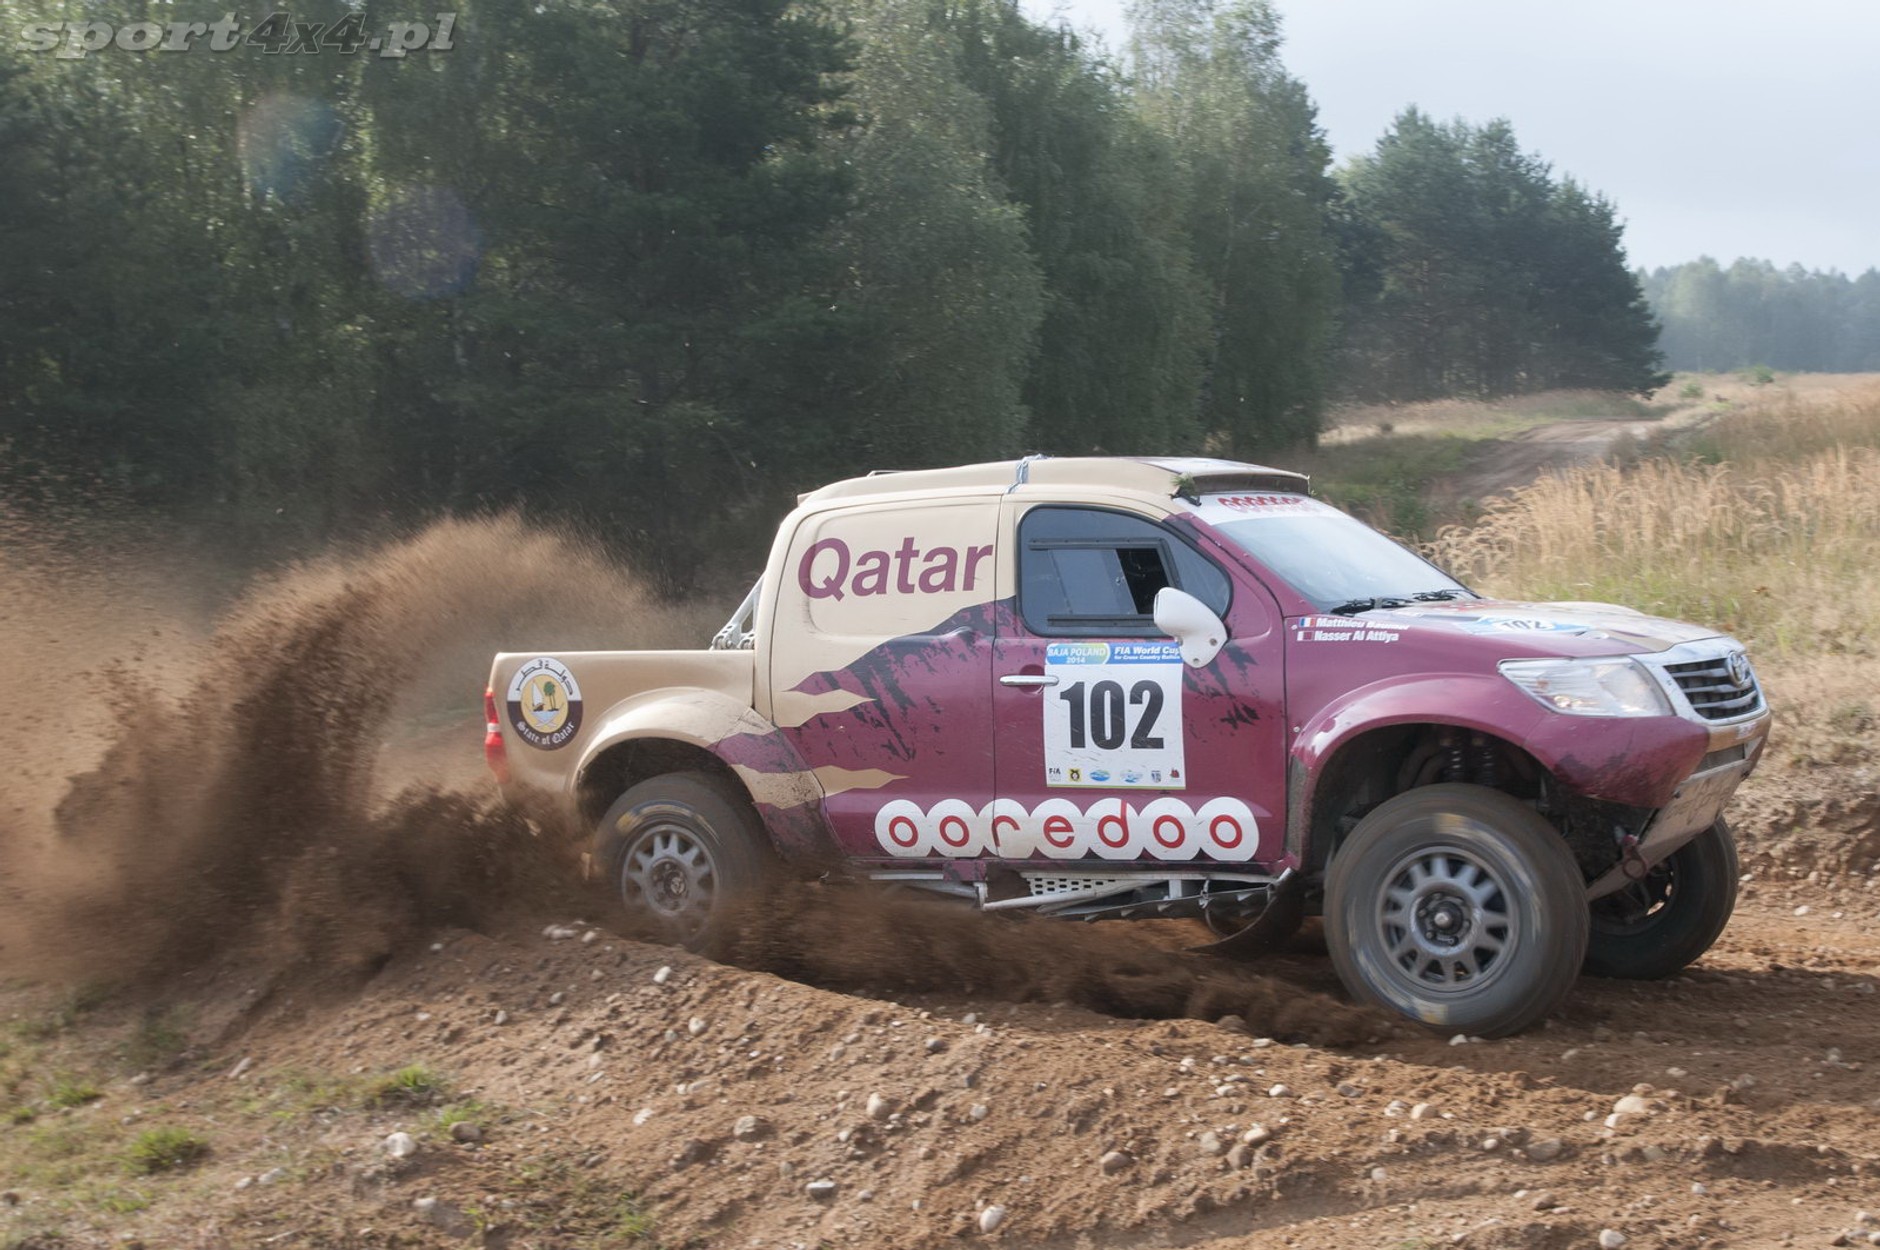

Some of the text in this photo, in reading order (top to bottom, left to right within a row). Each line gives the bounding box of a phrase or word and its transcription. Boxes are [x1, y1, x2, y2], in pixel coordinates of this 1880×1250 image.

[799, 536, 994, 602] Qatar
[1314, 630, 1350, 641] Nasser
[1352, 631, 1364, 641] Al
[1047, 647, 1106, 657] BAJA POLAND
[1114, 646, 1130, 655] FIA
[1133, 646, 1160, 655] World
[1066, 656, 1086, 664] 2014
[1060, 680, 1164, 750] 102
[888, 799, 1243, 849] ooredoo
